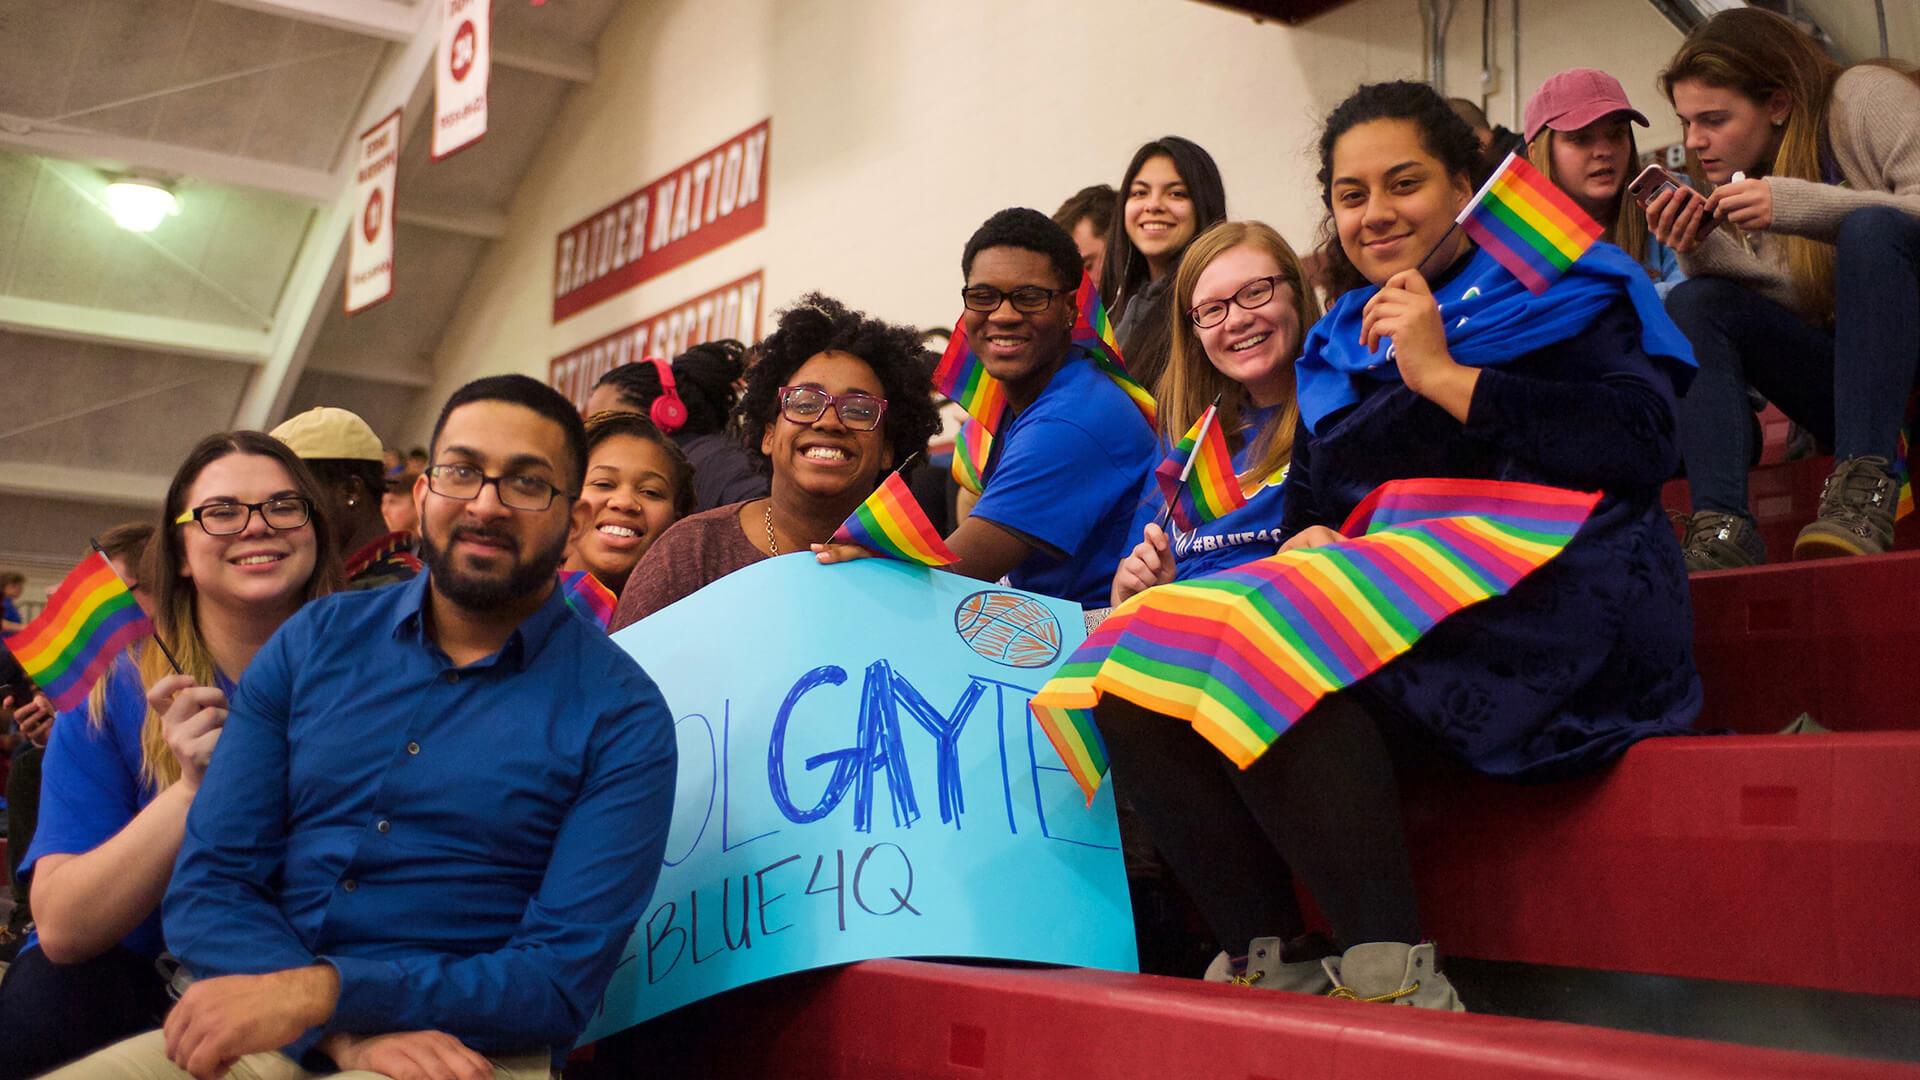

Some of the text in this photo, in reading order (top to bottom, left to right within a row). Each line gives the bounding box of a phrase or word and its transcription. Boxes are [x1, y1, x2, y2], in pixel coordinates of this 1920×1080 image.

[555, 127, 766, 299] RAIDER NATION
[661, 659, 1120, 867] OLGAYTE
[600, 842, 921, 1015] BLUE4Q
